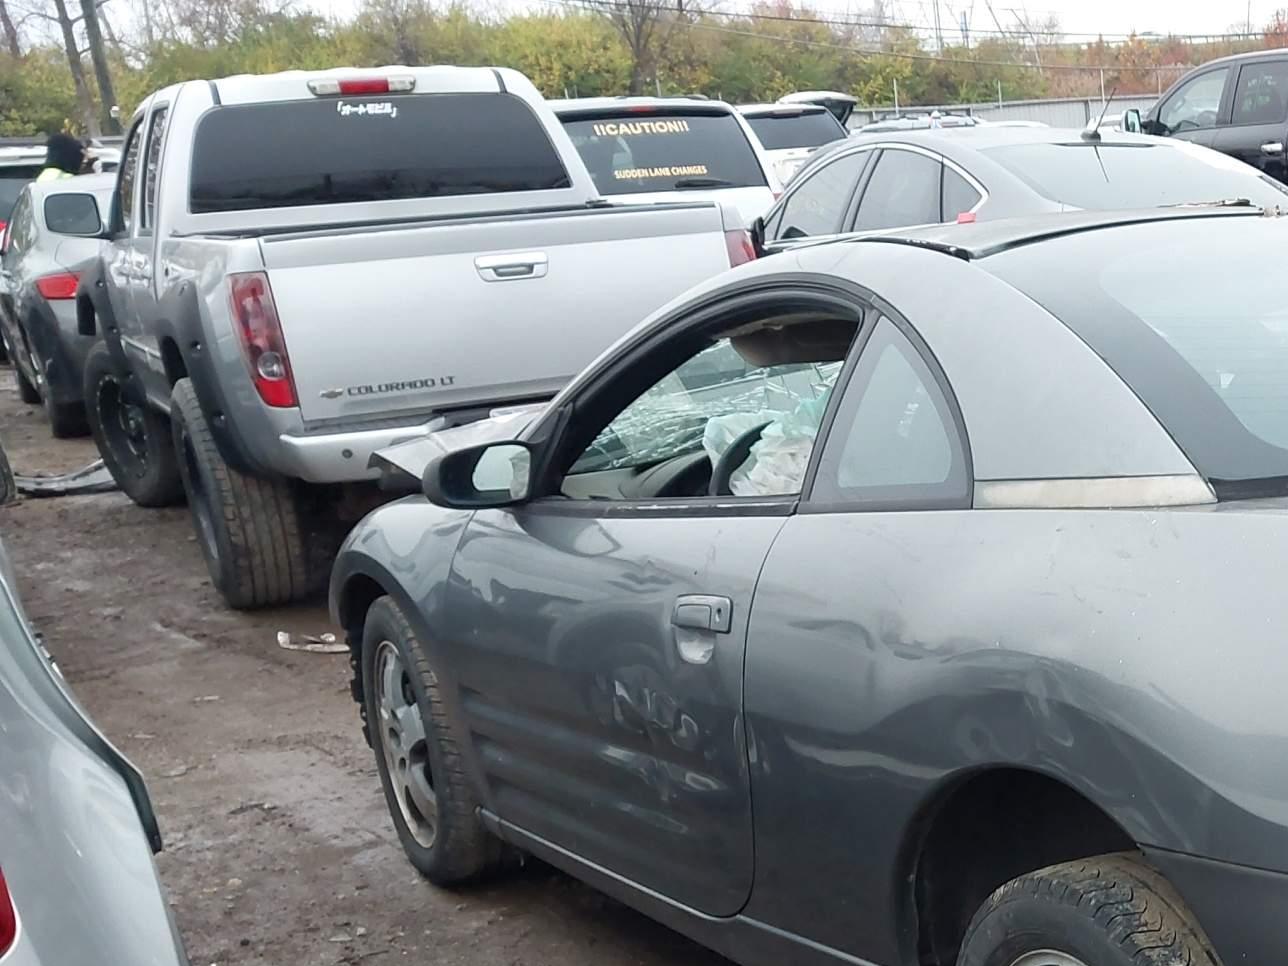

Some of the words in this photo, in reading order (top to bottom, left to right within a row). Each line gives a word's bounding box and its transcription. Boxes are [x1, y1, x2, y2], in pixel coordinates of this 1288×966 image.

[593, 120, 690, 136] !!CAUTION!!
[614, 168, 649, 179] SUDDEN
[650, 167, 671, 177] LANE
[671, 165, 707, 176] CHANGES
[347, 378, 435, 396] COLORADO
[440, 376, 455, 386] LT
